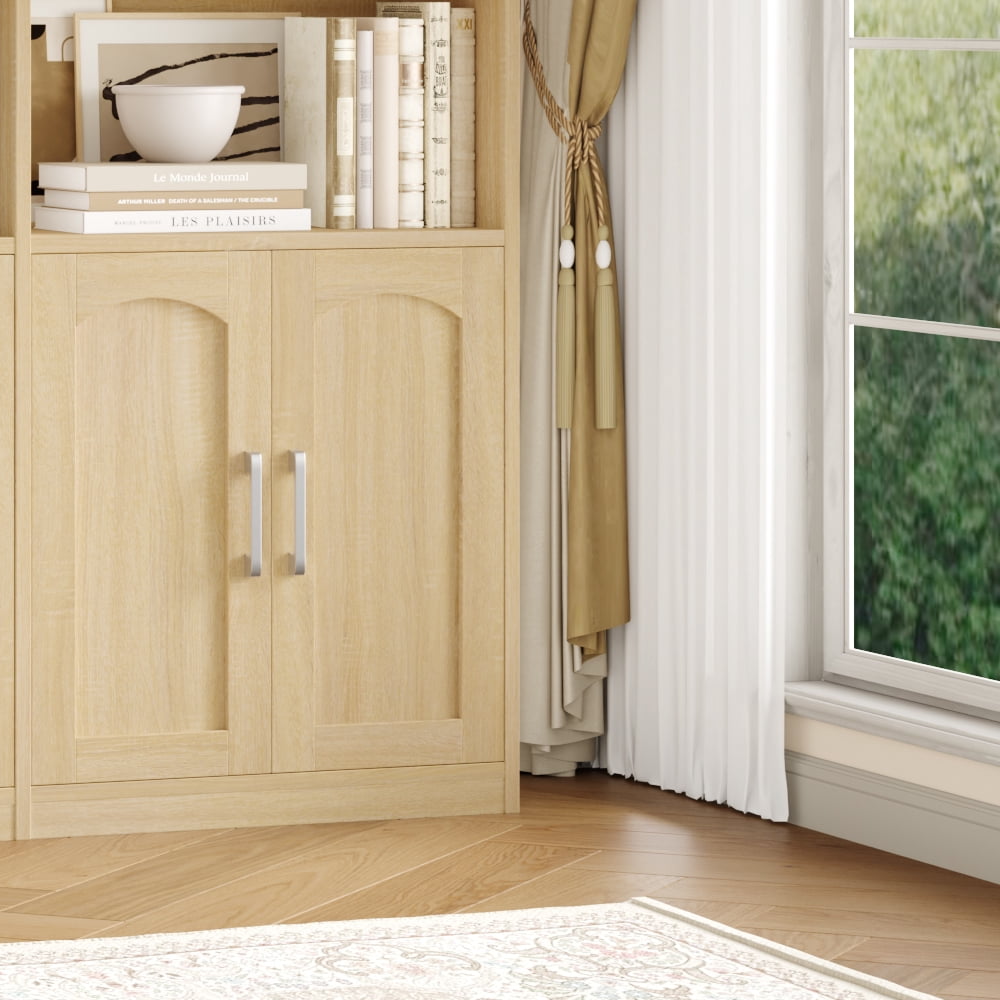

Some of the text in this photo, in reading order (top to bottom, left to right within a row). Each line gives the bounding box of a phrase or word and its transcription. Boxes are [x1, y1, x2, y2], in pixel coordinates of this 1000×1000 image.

[154, 172, 249, 183] Le Monde Journal
[172, 217, 198, 227] LES
[207, 216, 276, 226] PLAISIRS
